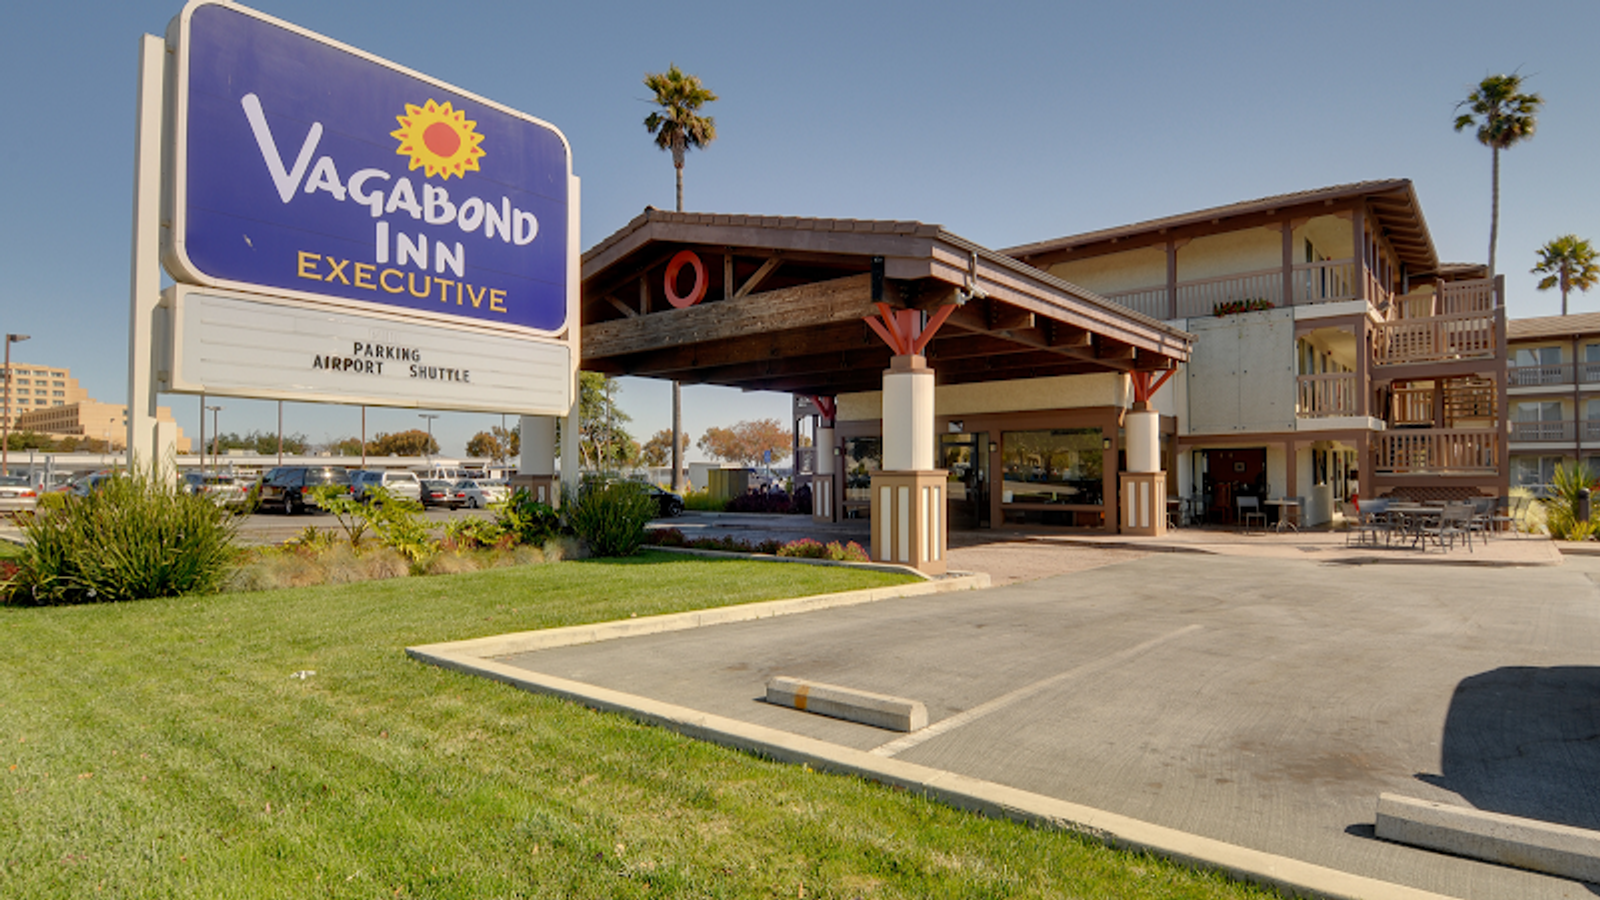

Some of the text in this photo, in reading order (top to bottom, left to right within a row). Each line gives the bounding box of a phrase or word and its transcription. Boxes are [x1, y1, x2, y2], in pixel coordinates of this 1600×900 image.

[241, 93, 539, 246] VAGABOND
[376, 221, 465, 277] INN
[297, 250, 508, 313] EXECUTIVE
[313, 354, 470, 383] AIRPORT SHUTTLE
[353, 341, 421, 363] PARKING
